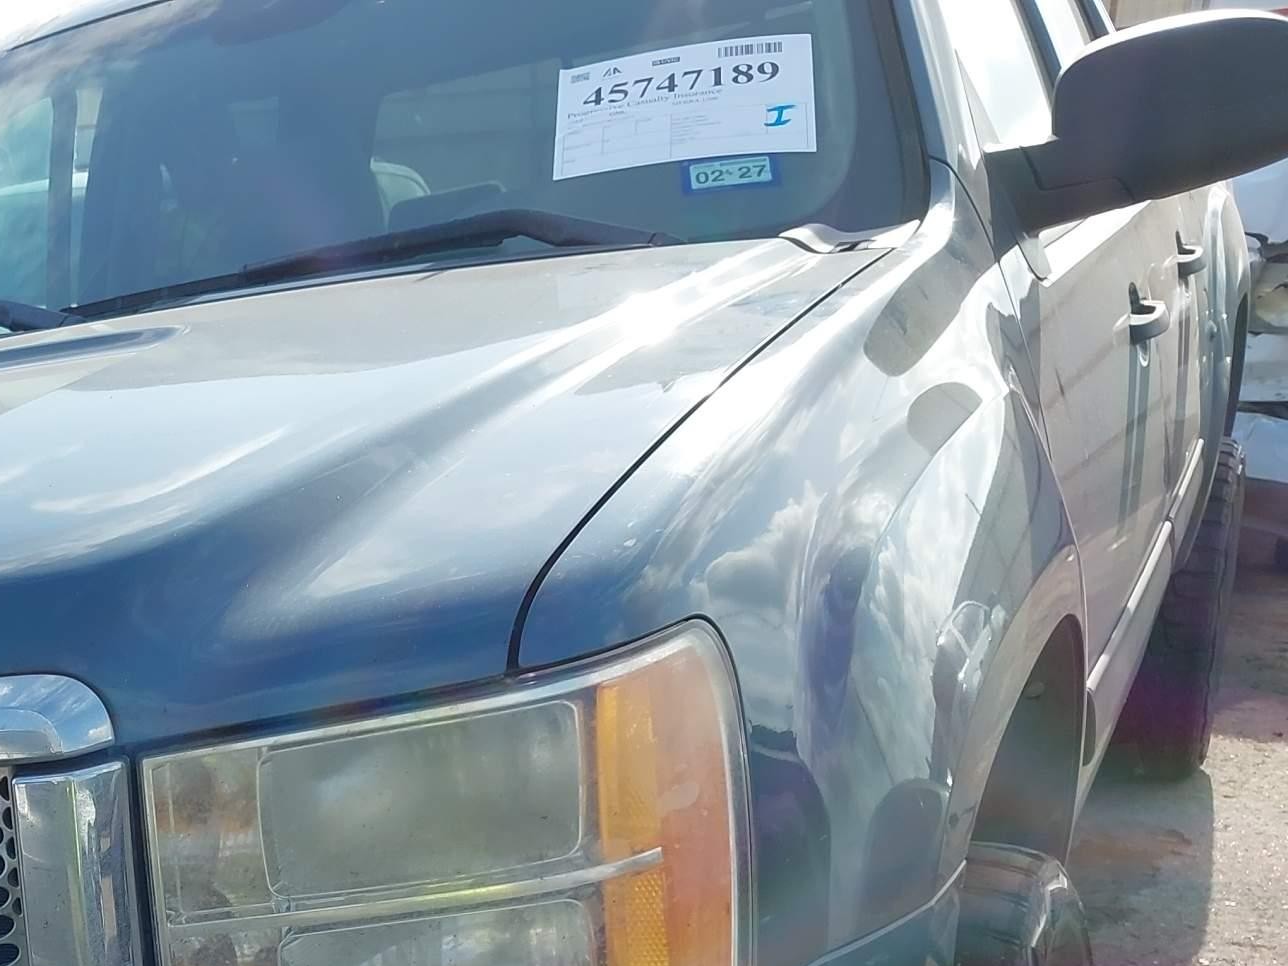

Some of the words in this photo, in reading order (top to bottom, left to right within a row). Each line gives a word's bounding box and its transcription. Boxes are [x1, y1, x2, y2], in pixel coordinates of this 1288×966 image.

[583, 61, 780, 107] 45747189
[695, 169, 725, 185] 02
[737, 164, 767, 179] 27
